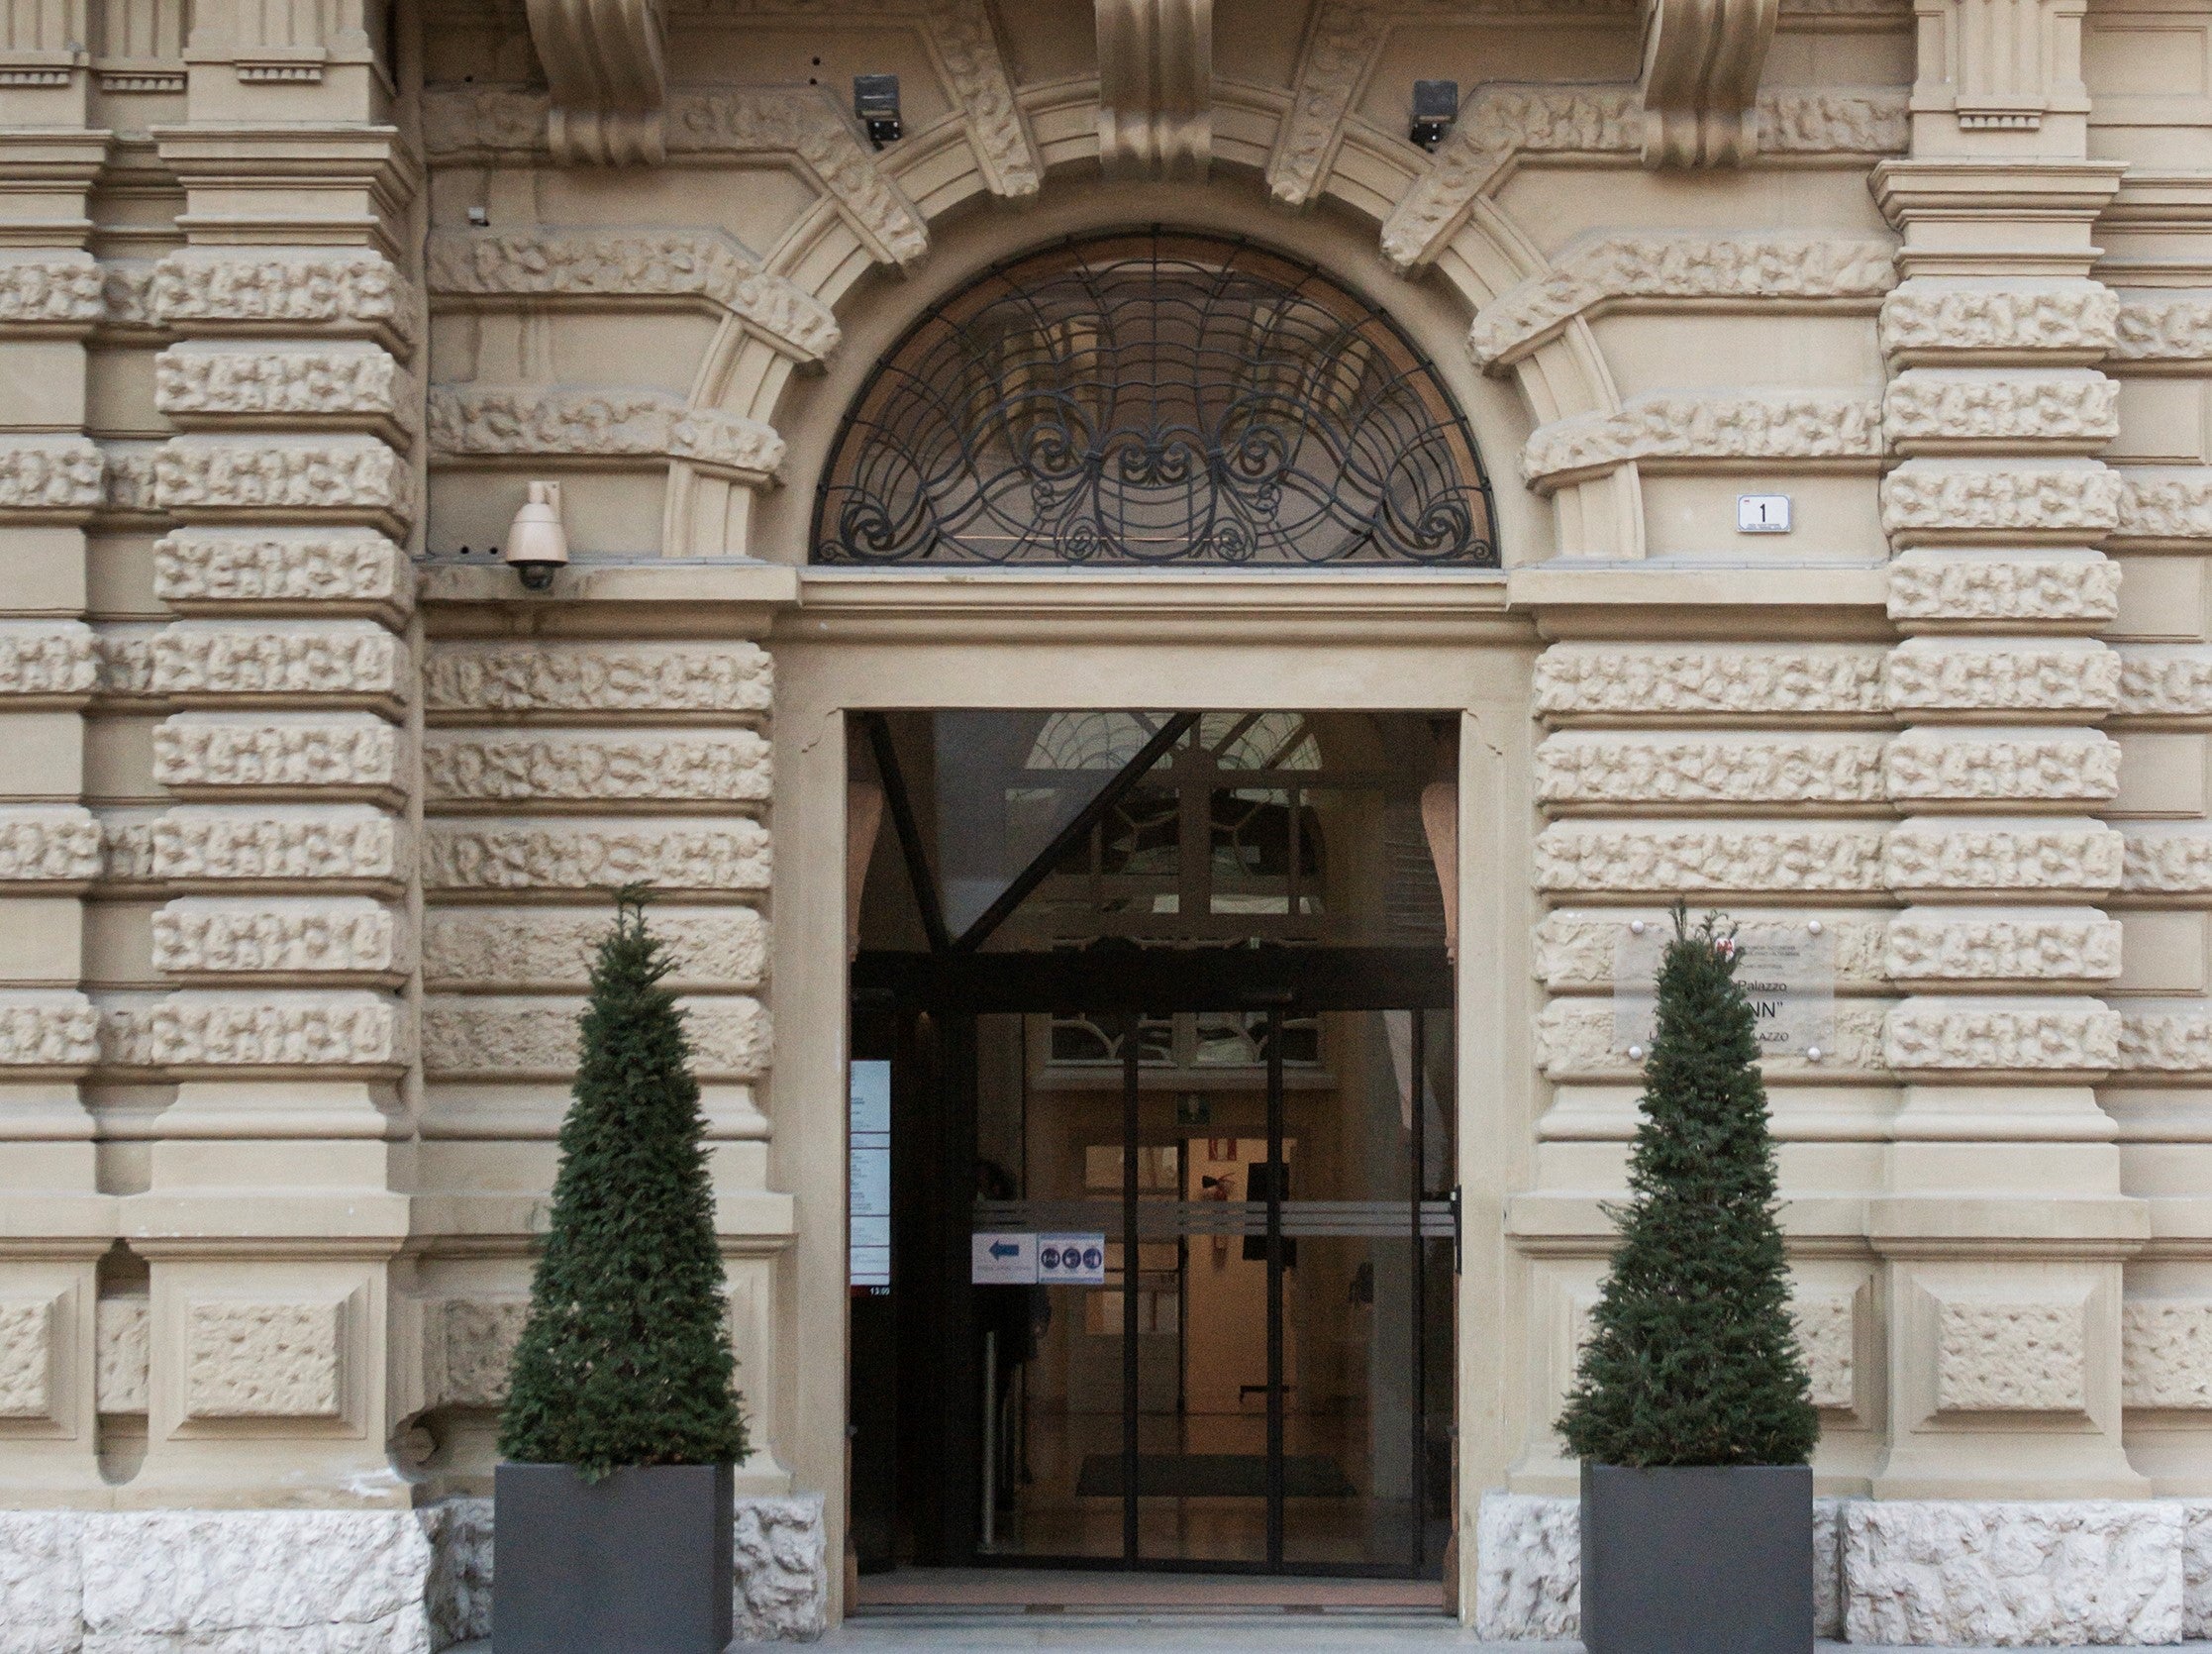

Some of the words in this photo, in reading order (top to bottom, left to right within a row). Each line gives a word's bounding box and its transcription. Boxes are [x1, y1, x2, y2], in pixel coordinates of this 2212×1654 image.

[1760, 503, 1765, 523] 1
[1738, 980, 1787, 991] Palazzo
[1747, 1000, 1783, 1018] NN"
[1756, 1031, 1789, 1042] AZZO
